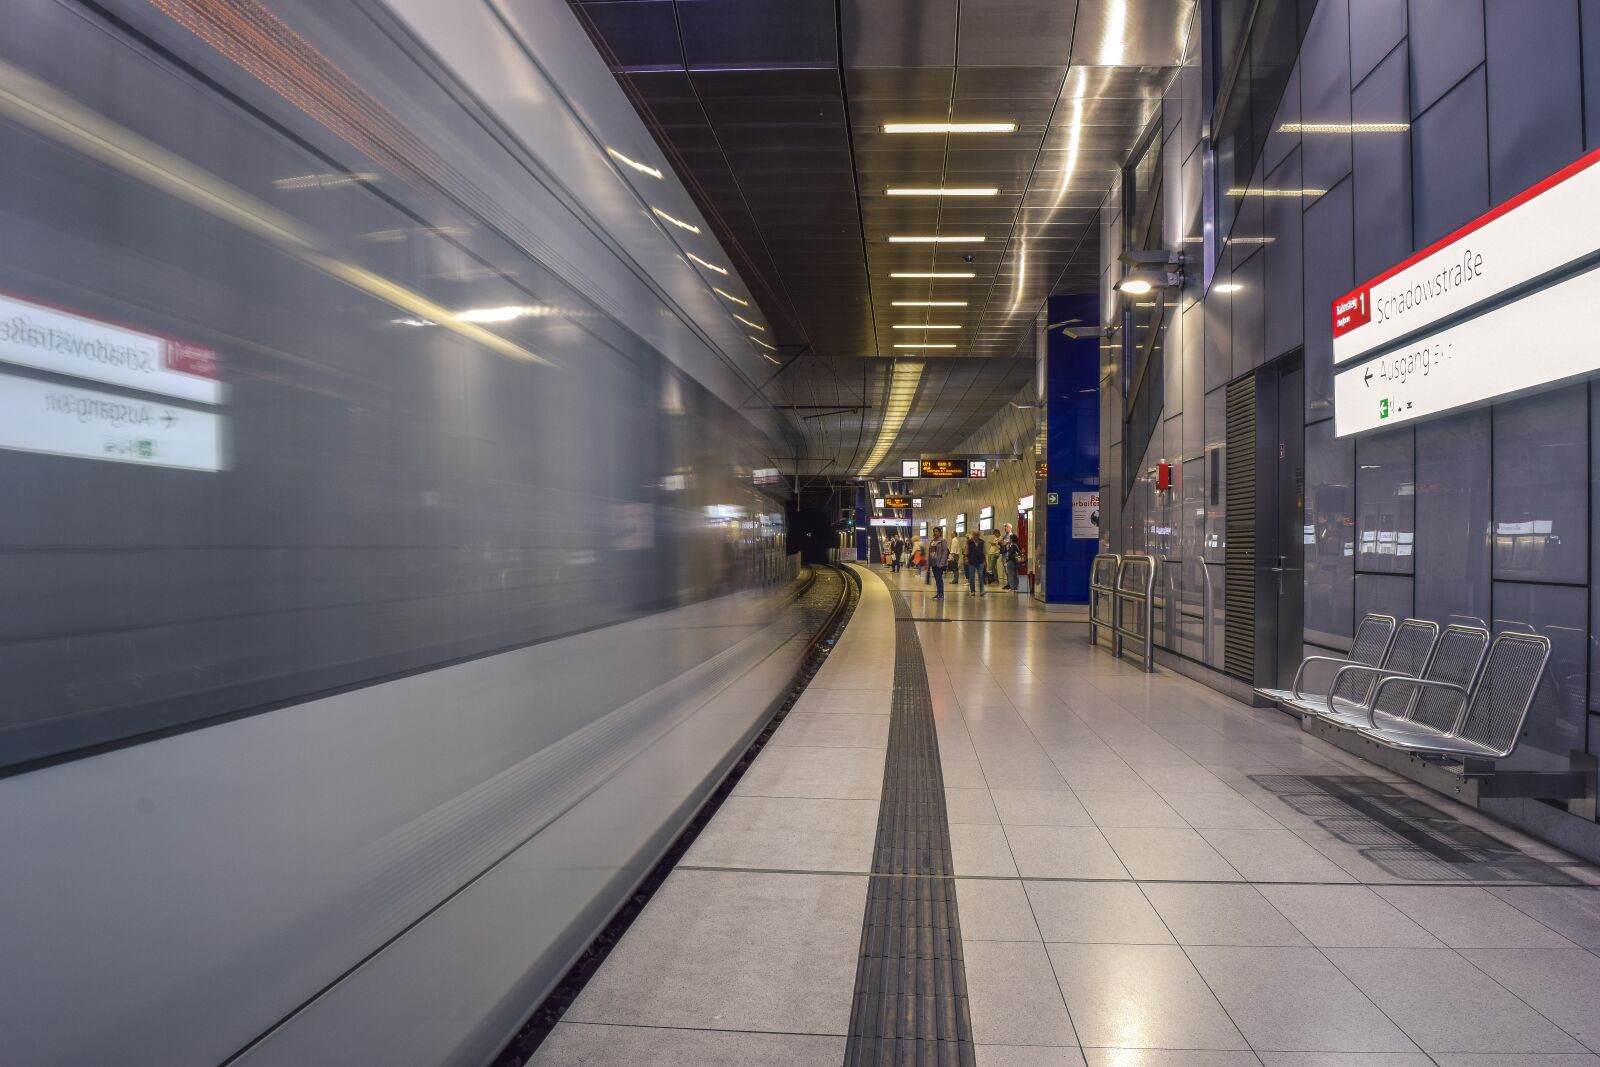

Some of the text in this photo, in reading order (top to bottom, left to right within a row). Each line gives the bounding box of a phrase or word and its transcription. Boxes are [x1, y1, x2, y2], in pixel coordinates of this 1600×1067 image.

[1359, 292, 1365, 315] 1
[1377, 249, 1483, 324] Schadowstraße
[1380, 348, 1430, 384] Ausgang
